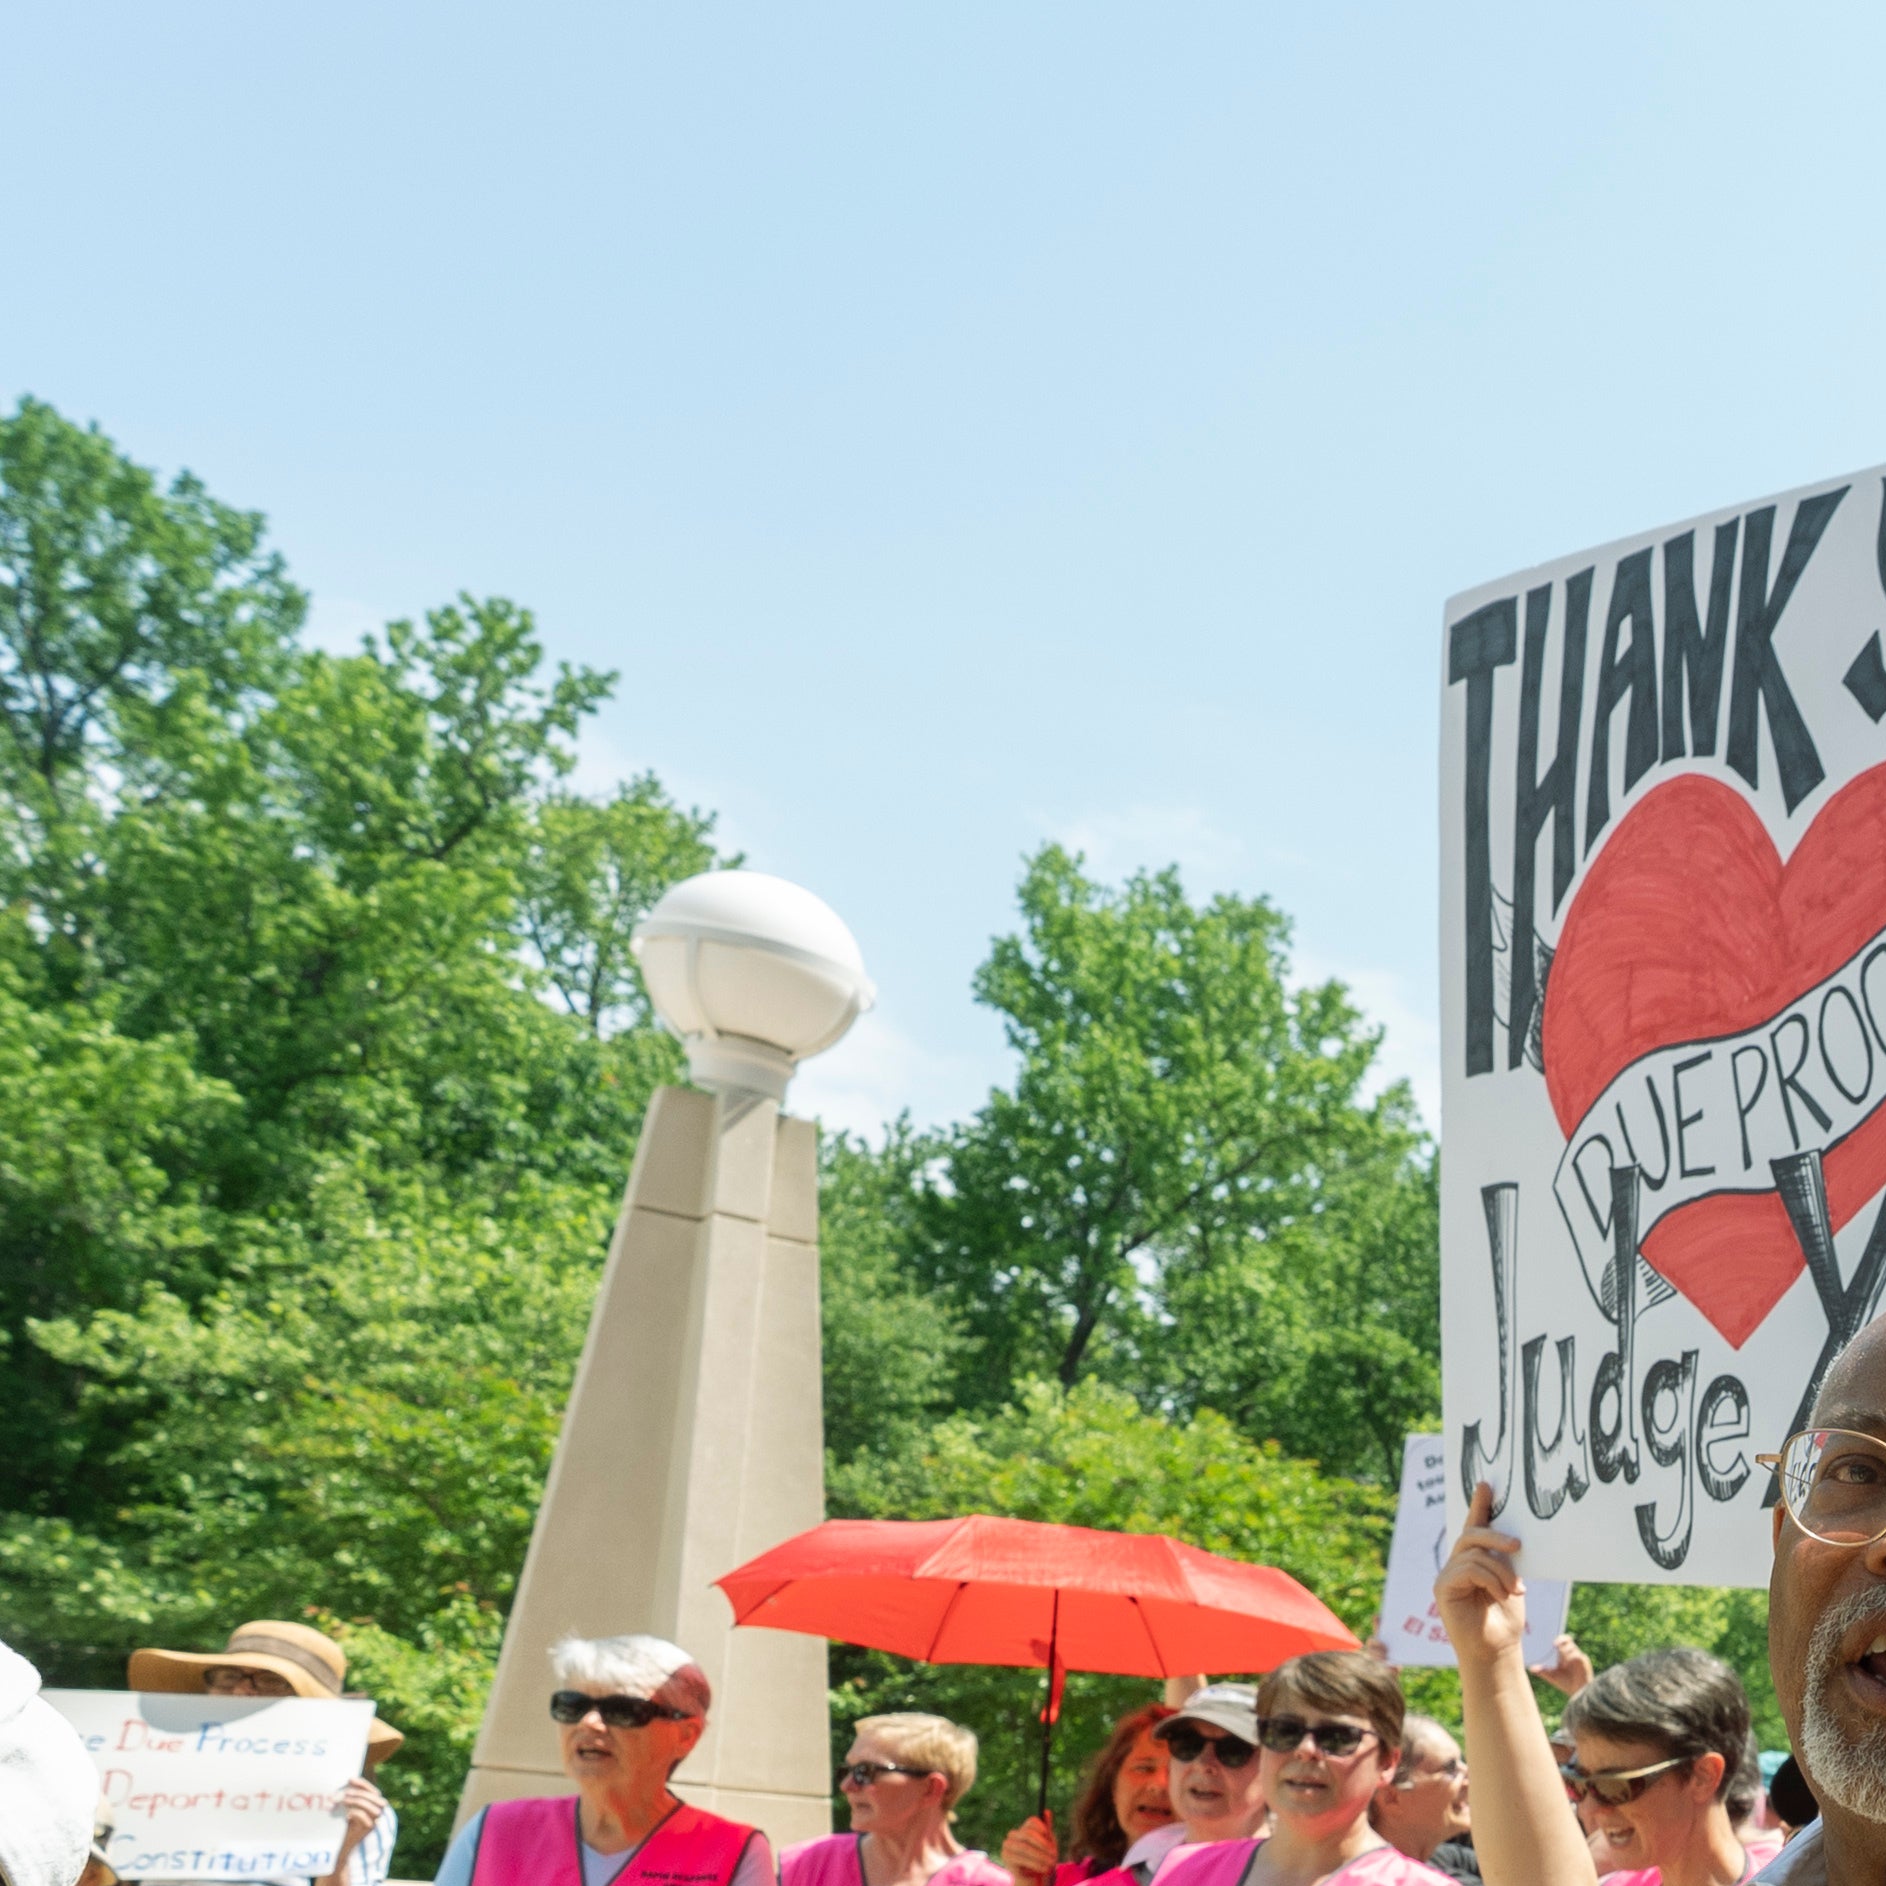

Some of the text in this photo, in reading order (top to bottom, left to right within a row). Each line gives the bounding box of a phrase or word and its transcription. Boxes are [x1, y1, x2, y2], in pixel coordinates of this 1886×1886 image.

[1449, 484, 1852, 1076] THANK
[1568, 1047, 1716, 1240] DUE
[1461, 1163, 1752, 1570] Judge
[103, 1768, 337, 1818] Deportations
[114, 1718, 185, 1754] Due
[195, 1720, 329, 1756] Process
[113, 1833, 331, 1873] Constitution
